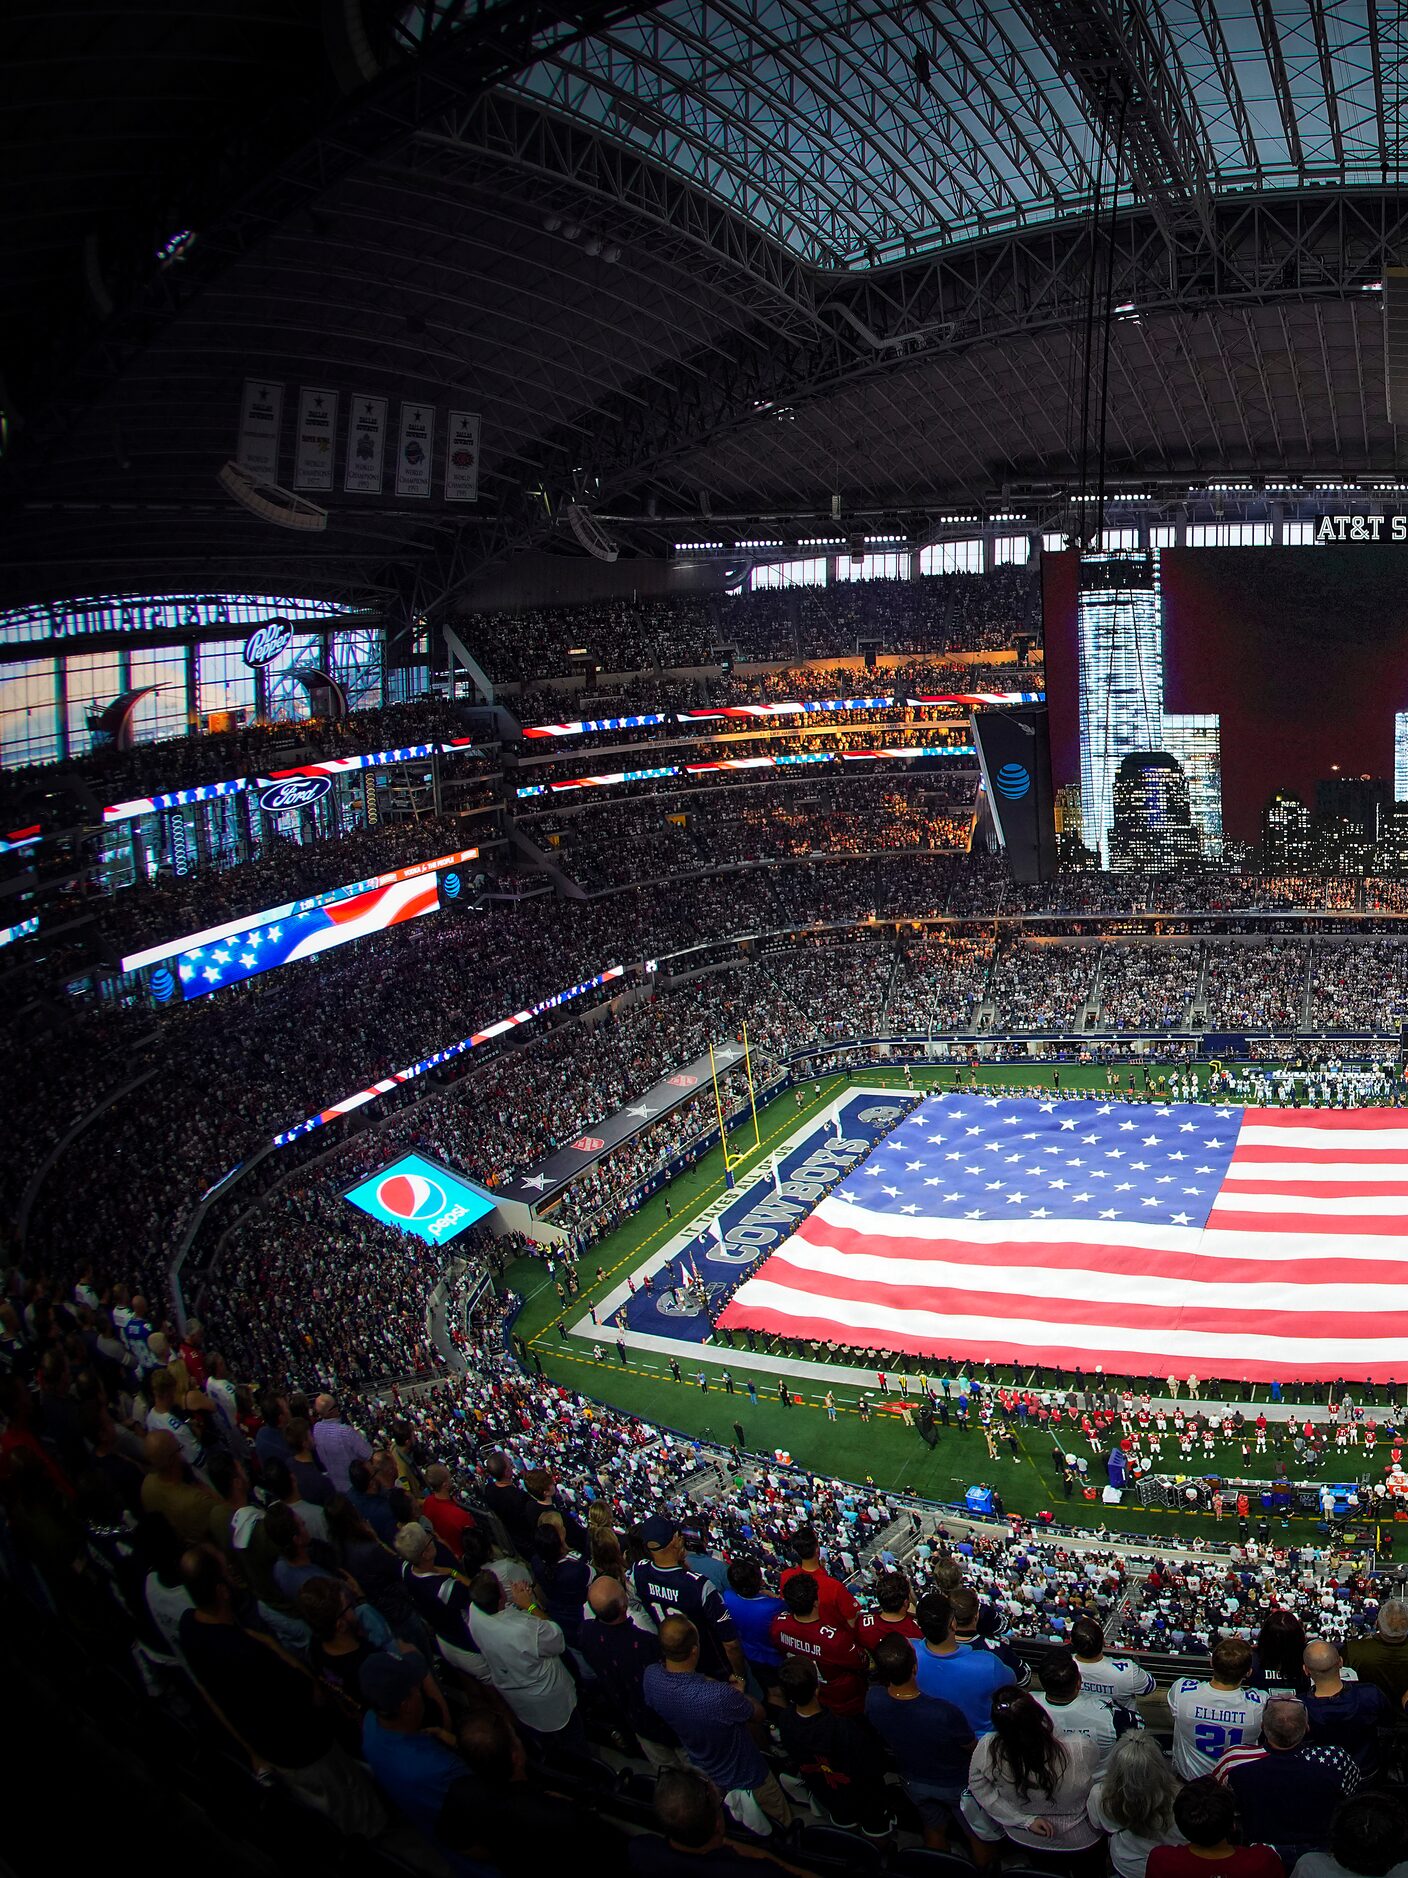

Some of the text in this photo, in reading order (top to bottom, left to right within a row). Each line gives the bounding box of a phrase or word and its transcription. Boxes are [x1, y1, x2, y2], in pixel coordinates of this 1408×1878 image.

[1316, 515, 1384, 540] AT&T
[252, 627, 292, 662] Pepper
[263, 622, 283, 644] Dr
[272, 780, 319, 808] Ford
[679, 1226, 699, 1239] IT
[696, 1192, 739, 1224] TAKES
[736, 1171, 762, 1191] ALL
[775, 1145, 795, 1159] US
[706, 1138, 870, 1264] COWBOYS
[427, 1203, 471, 1237] pepsi
[647, 1582, 679, 1603] BRADY
[779, 1632, 811, 1654] WINFIELD
[1111, 1661, 1129, 1673] 4
[1180, 1679, 1199, 1693] 21
[1195, 1706, 1246, 1724] ELLIOTT
[1194, 1723, 1244, 1761] 21
